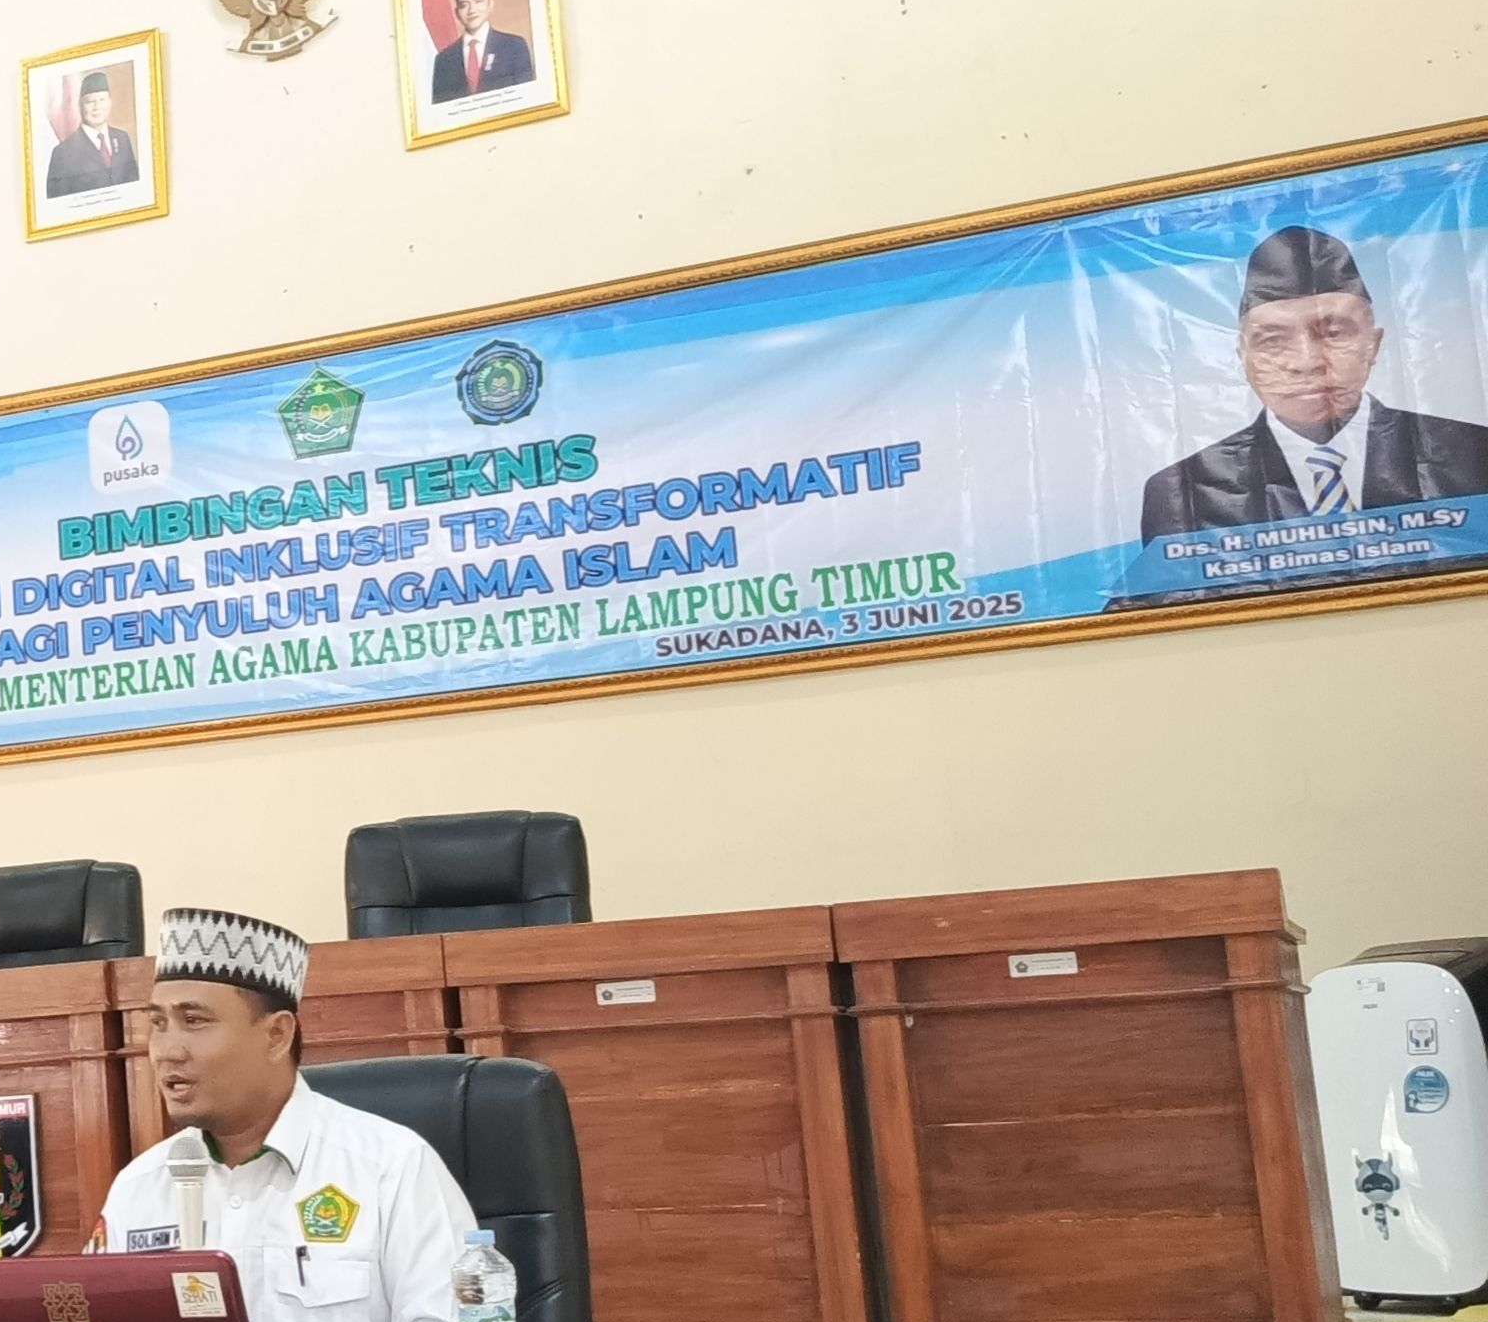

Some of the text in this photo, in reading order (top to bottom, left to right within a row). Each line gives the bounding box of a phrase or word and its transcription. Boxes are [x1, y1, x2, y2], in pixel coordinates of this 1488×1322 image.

[58, 434, 598, 560] BIMBINGAN TEKNIS
[103, 462, 159, 486] pusaka
[13, 556, 194, 615] DIGITAL
[205, 518, 429, 587] INKLUSIF
[441, 441, 921, 552] TRANSFORMATIF
[1165, 509, 1466, 559] Drs. H. MUHLISIN, M.Sy
[1205, 538, 1431, 577] Kasi Bimas Islam
[83, 583, 340, 655] PENYULUH
[352, 555, 553, 619] AGAMA
[563, 527, 737, 591] ISLAM
[209, 636, 338, 685] AGAMA
[349, 602, 582, 667] KABUPATEN
[596, 573, 798, 636] LAMPUNG
[811, 552, 960, 608] TIMUR
[656, 593, 1022, 656] SUKADANA, 3 JUNI 2025
